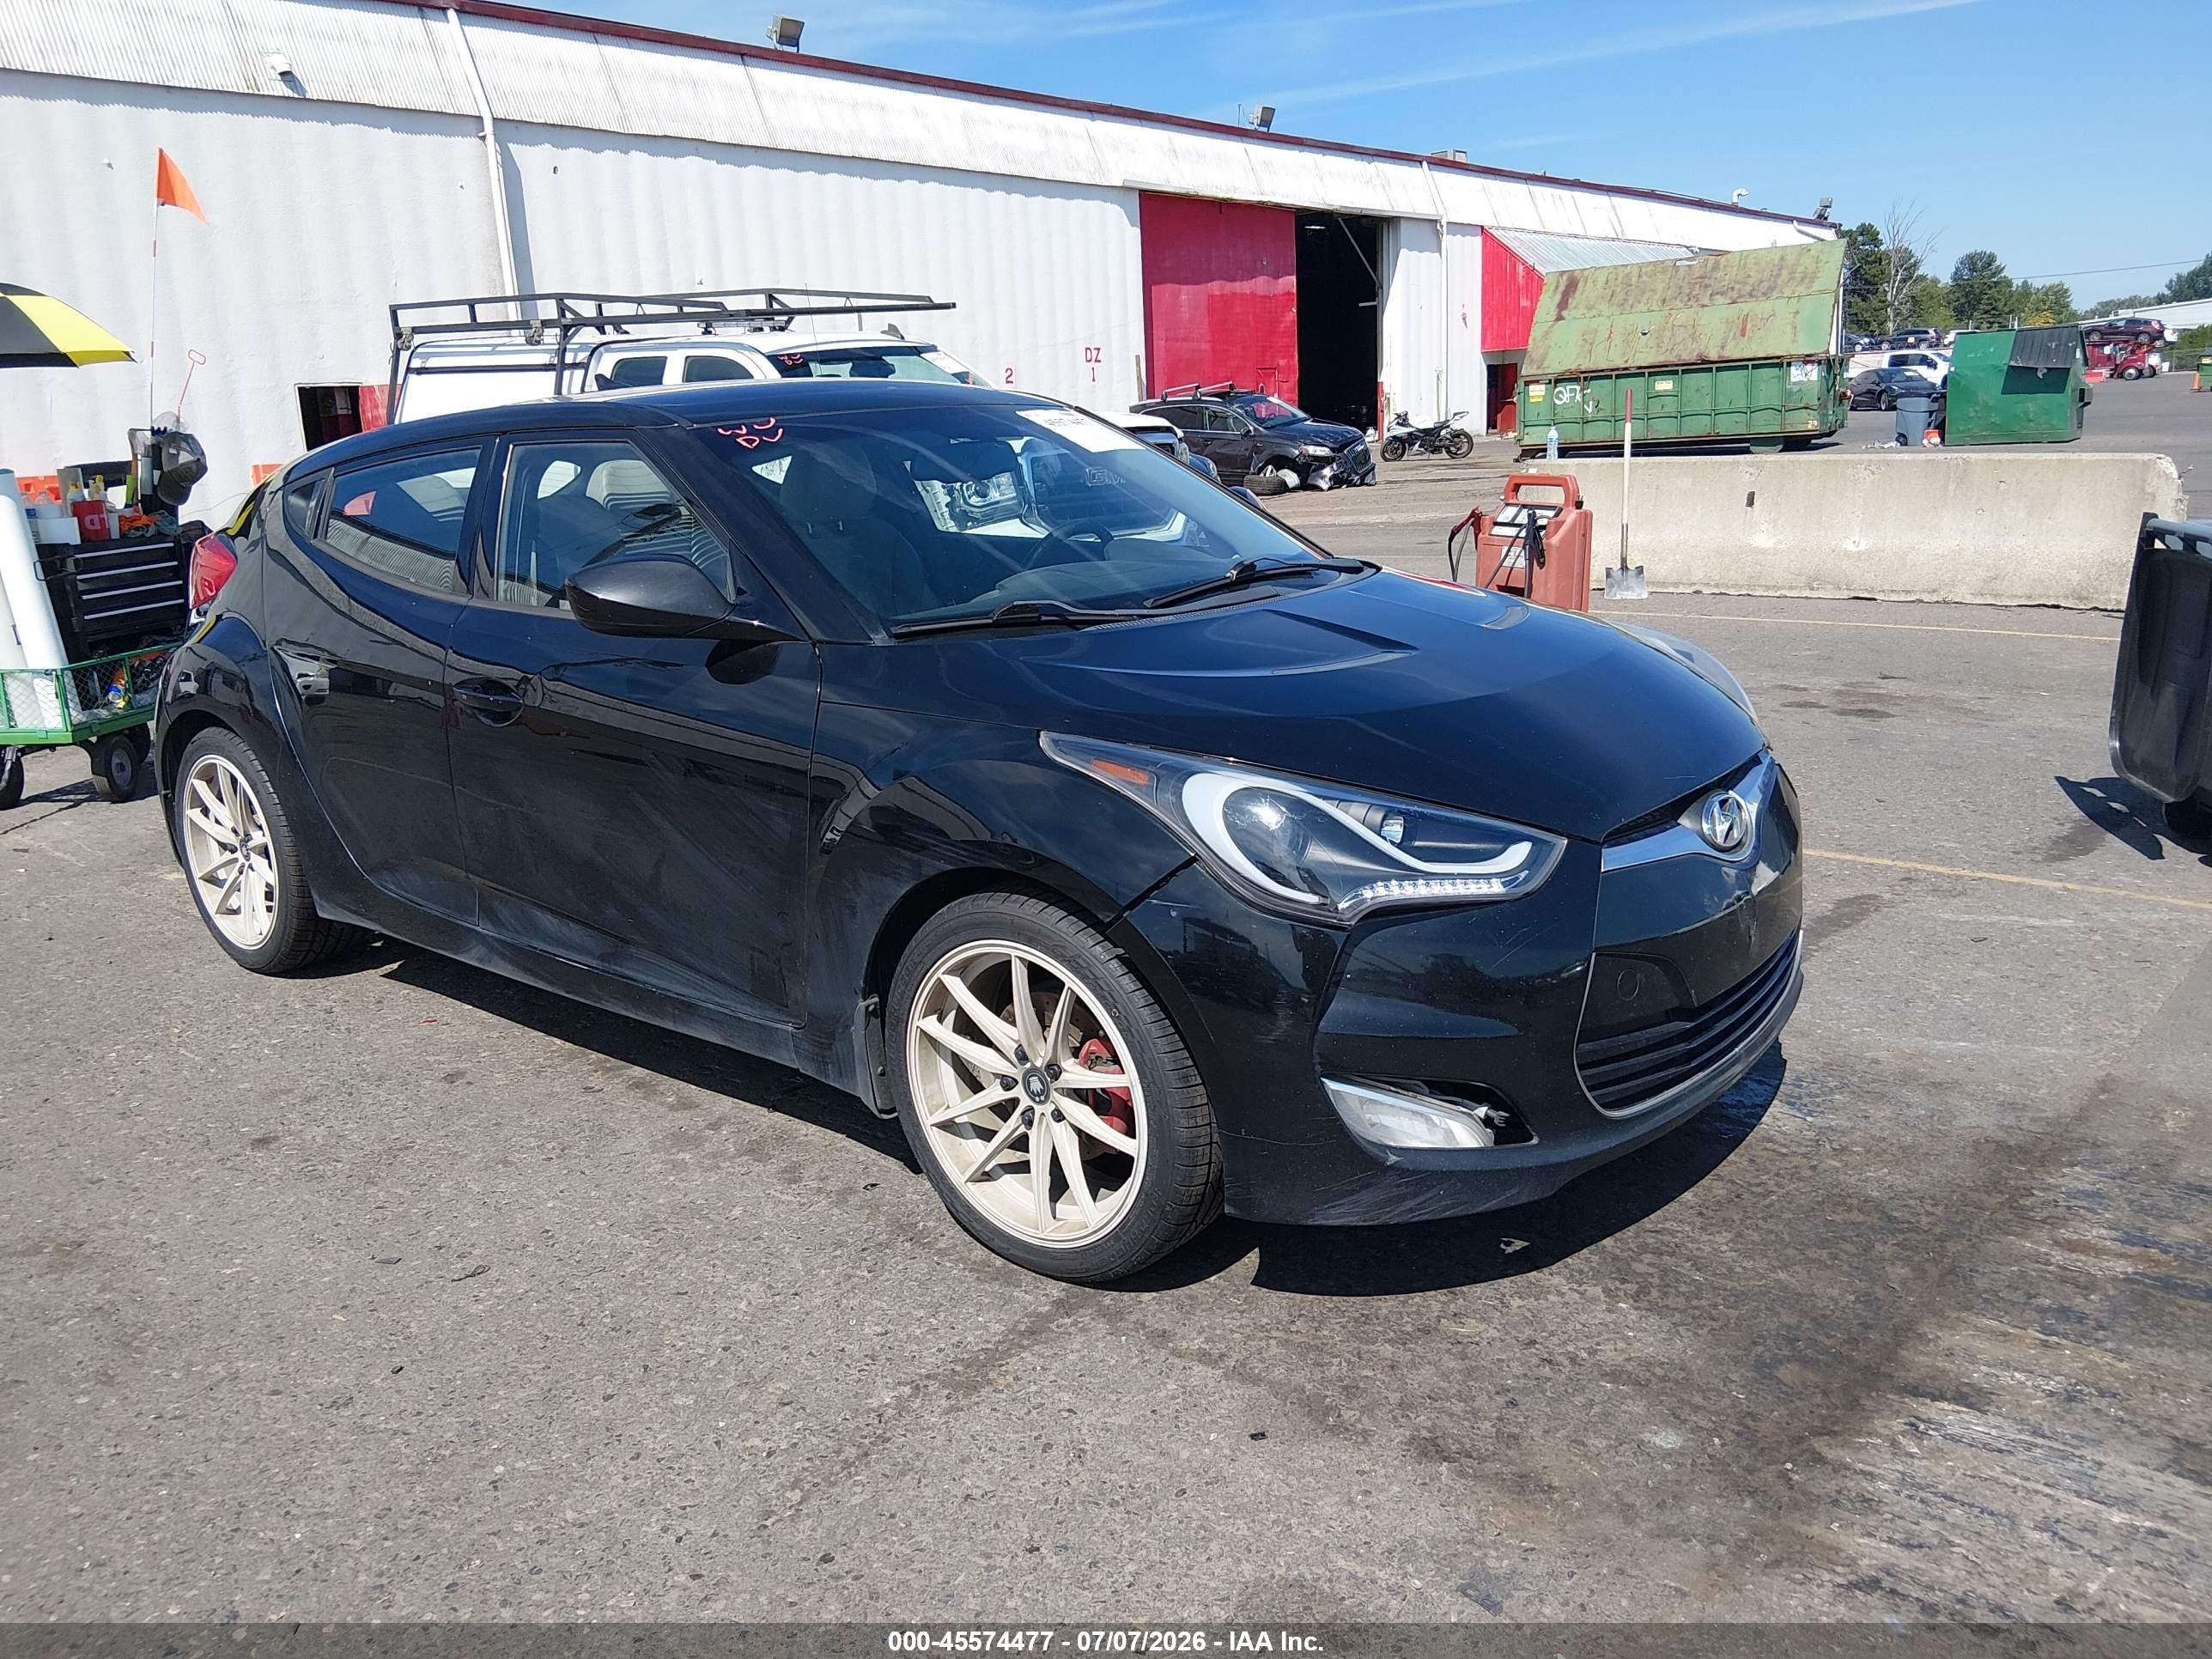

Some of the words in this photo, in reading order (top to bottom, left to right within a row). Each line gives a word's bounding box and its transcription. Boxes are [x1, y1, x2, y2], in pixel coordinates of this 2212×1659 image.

[1085, 346, 1102, 364] DZ
[1005, 367, 1014, 385] 2
[1091, 367, 1097, 383] 1
[1085, 466, 1126, 487] GM
